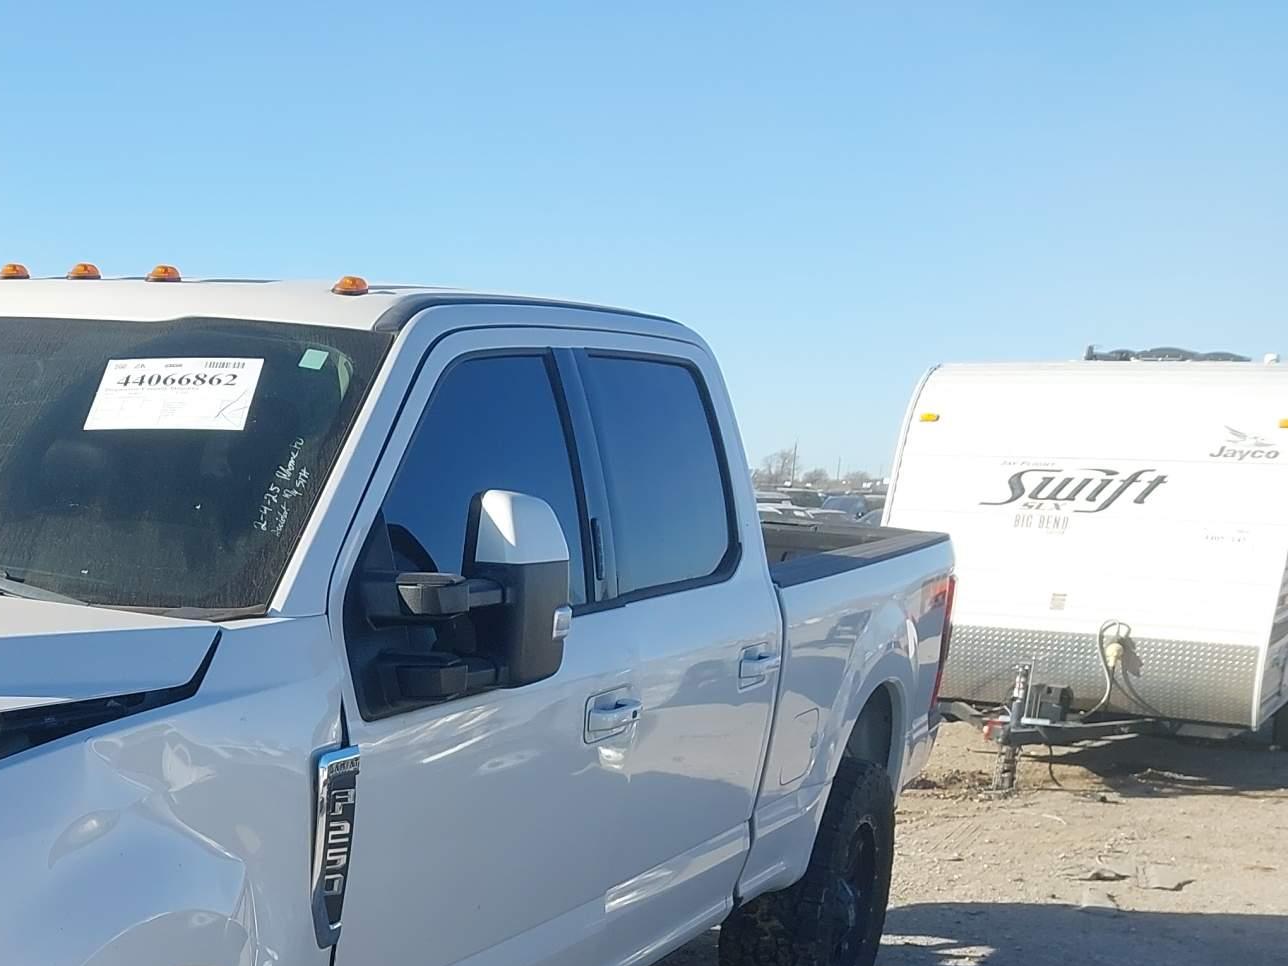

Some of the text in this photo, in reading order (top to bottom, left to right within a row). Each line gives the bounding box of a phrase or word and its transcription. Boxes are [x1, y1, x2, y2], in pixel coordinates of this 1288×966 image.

[117, 373, 238, 387] 44066862
[1209, 445, 1280, 461] Jayco
[979, 468, 1168, 514] Swift
[1013, 513, 1069, 530] BIG BEND
